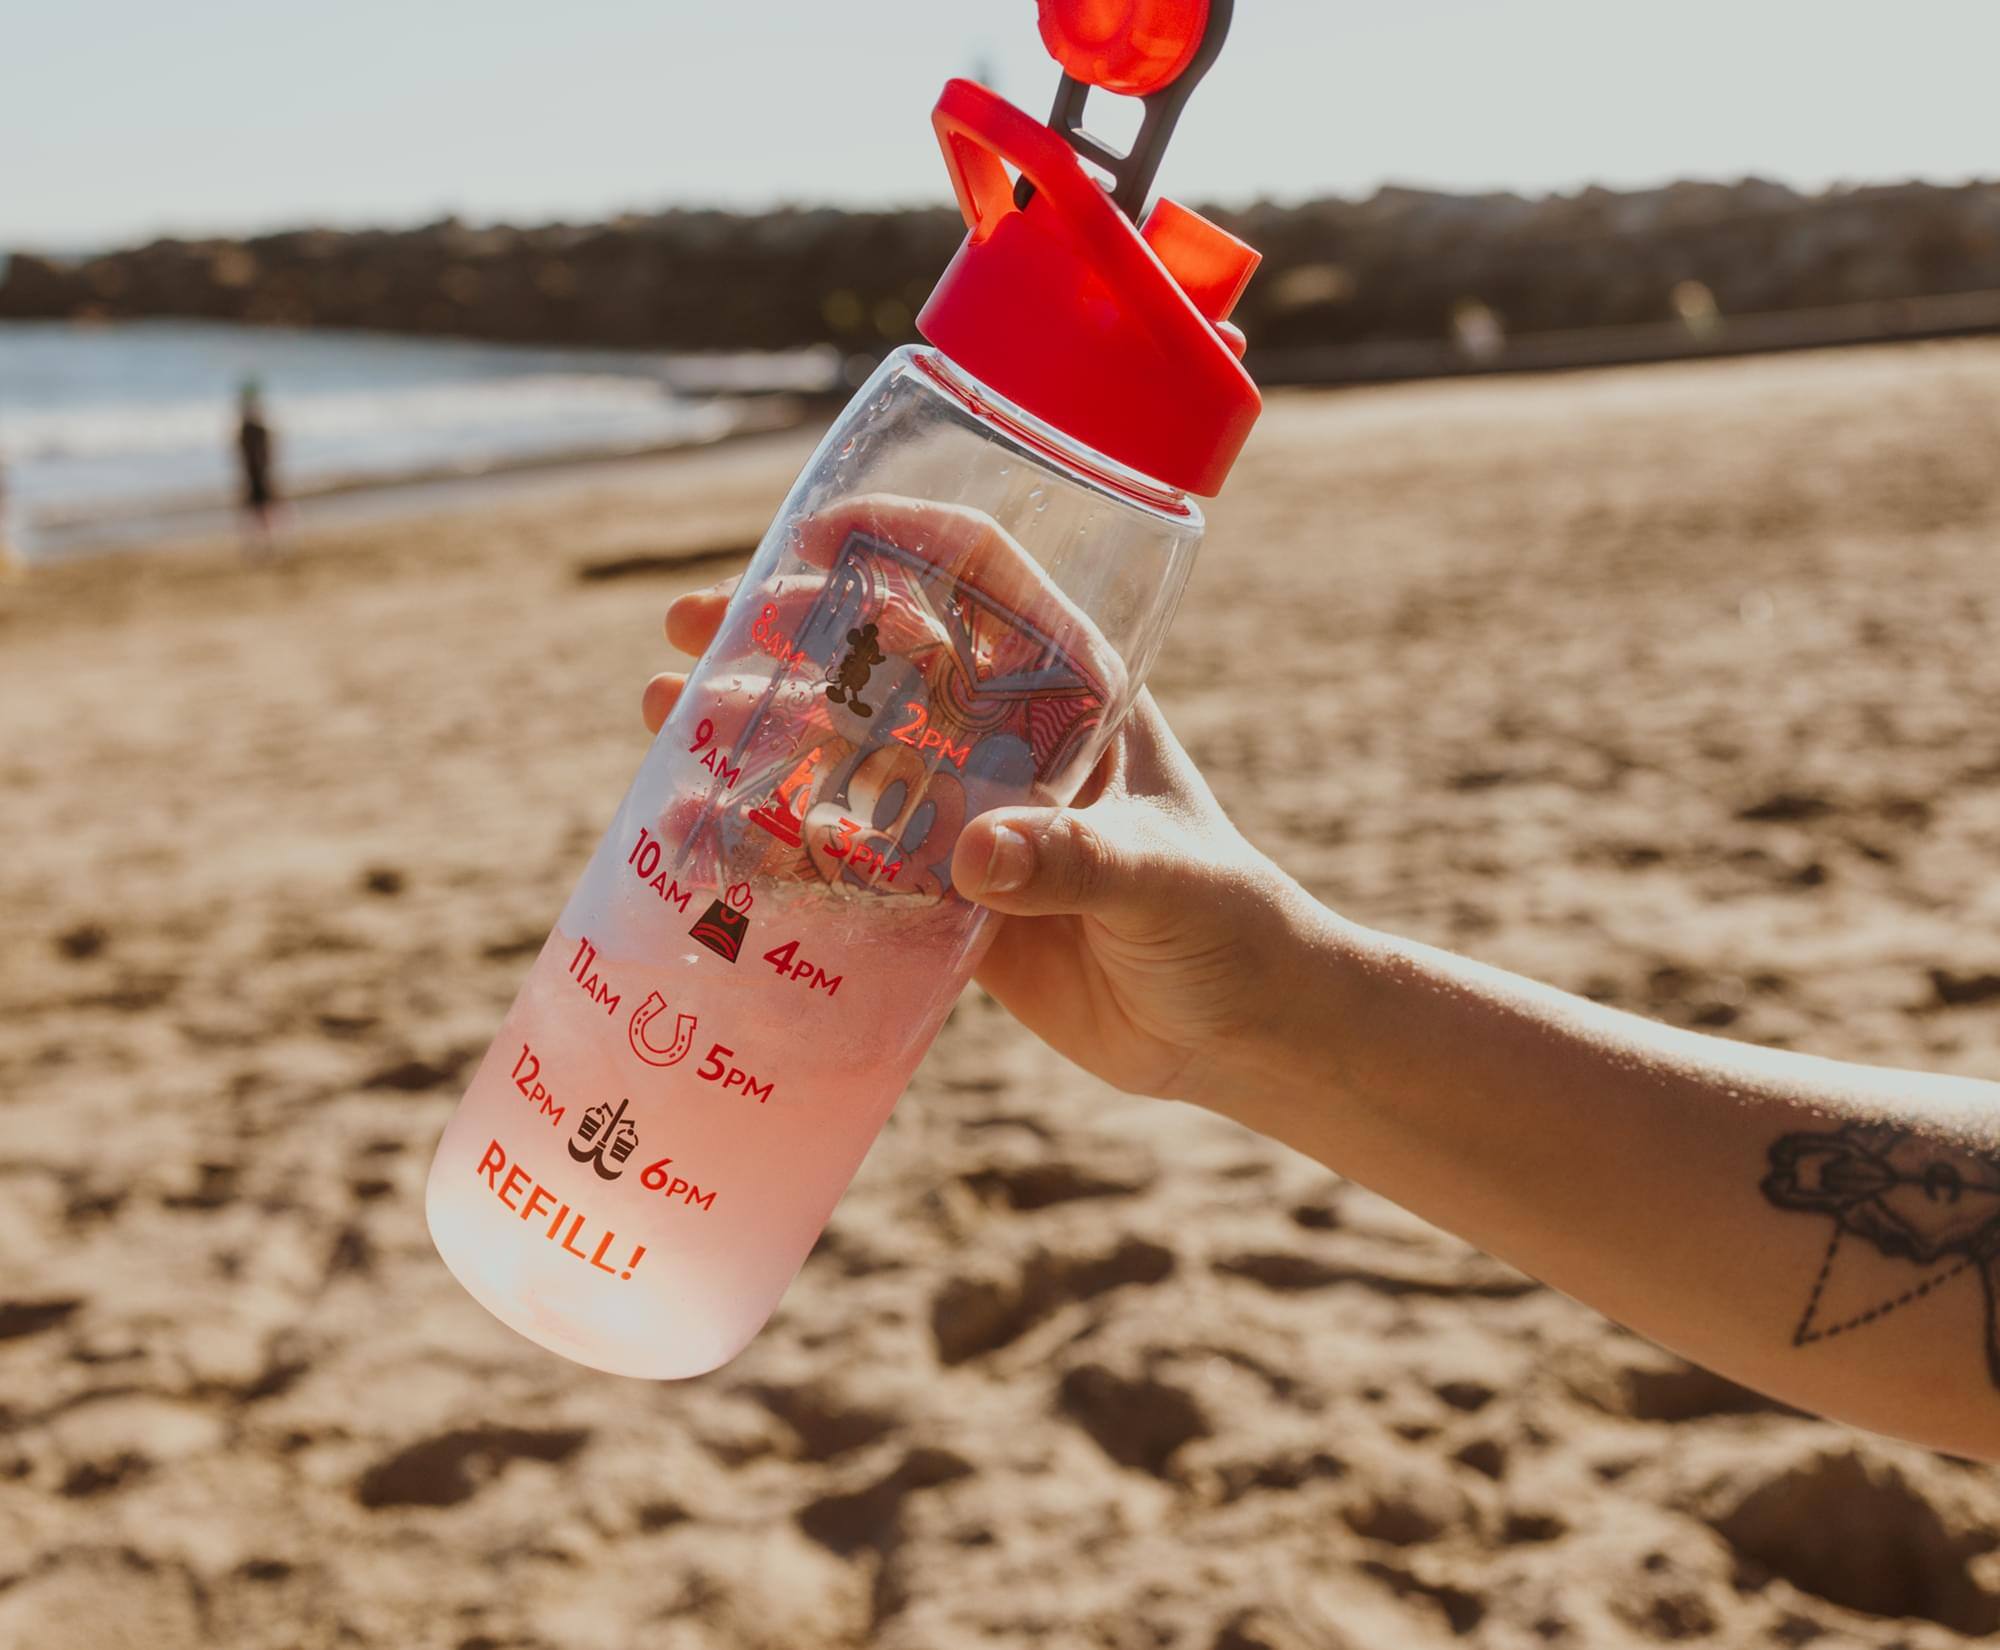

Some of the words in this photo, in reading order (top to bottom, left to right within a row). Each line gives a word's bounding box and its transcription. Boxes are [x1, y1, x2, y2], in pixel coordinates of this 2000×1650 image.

[750, 602, 807, 673] 8AM
[689, 718, 741, 790] 9AM
[890, 702, 971, 769] 2PM
[627, 828, 692, 914] 10AM
[823, 817, 900, 883] 3PM
[568, 936, 621, 1015] 11AM
[762, 940, 843, 996] 4PM
[511, 1043, 566, 1127] 12PM
[696, 1044, 775, 1104] 5PM
[476, 1139, 647, 1280] REFILL!
[640, 1158, 718, 1211] 6PM
